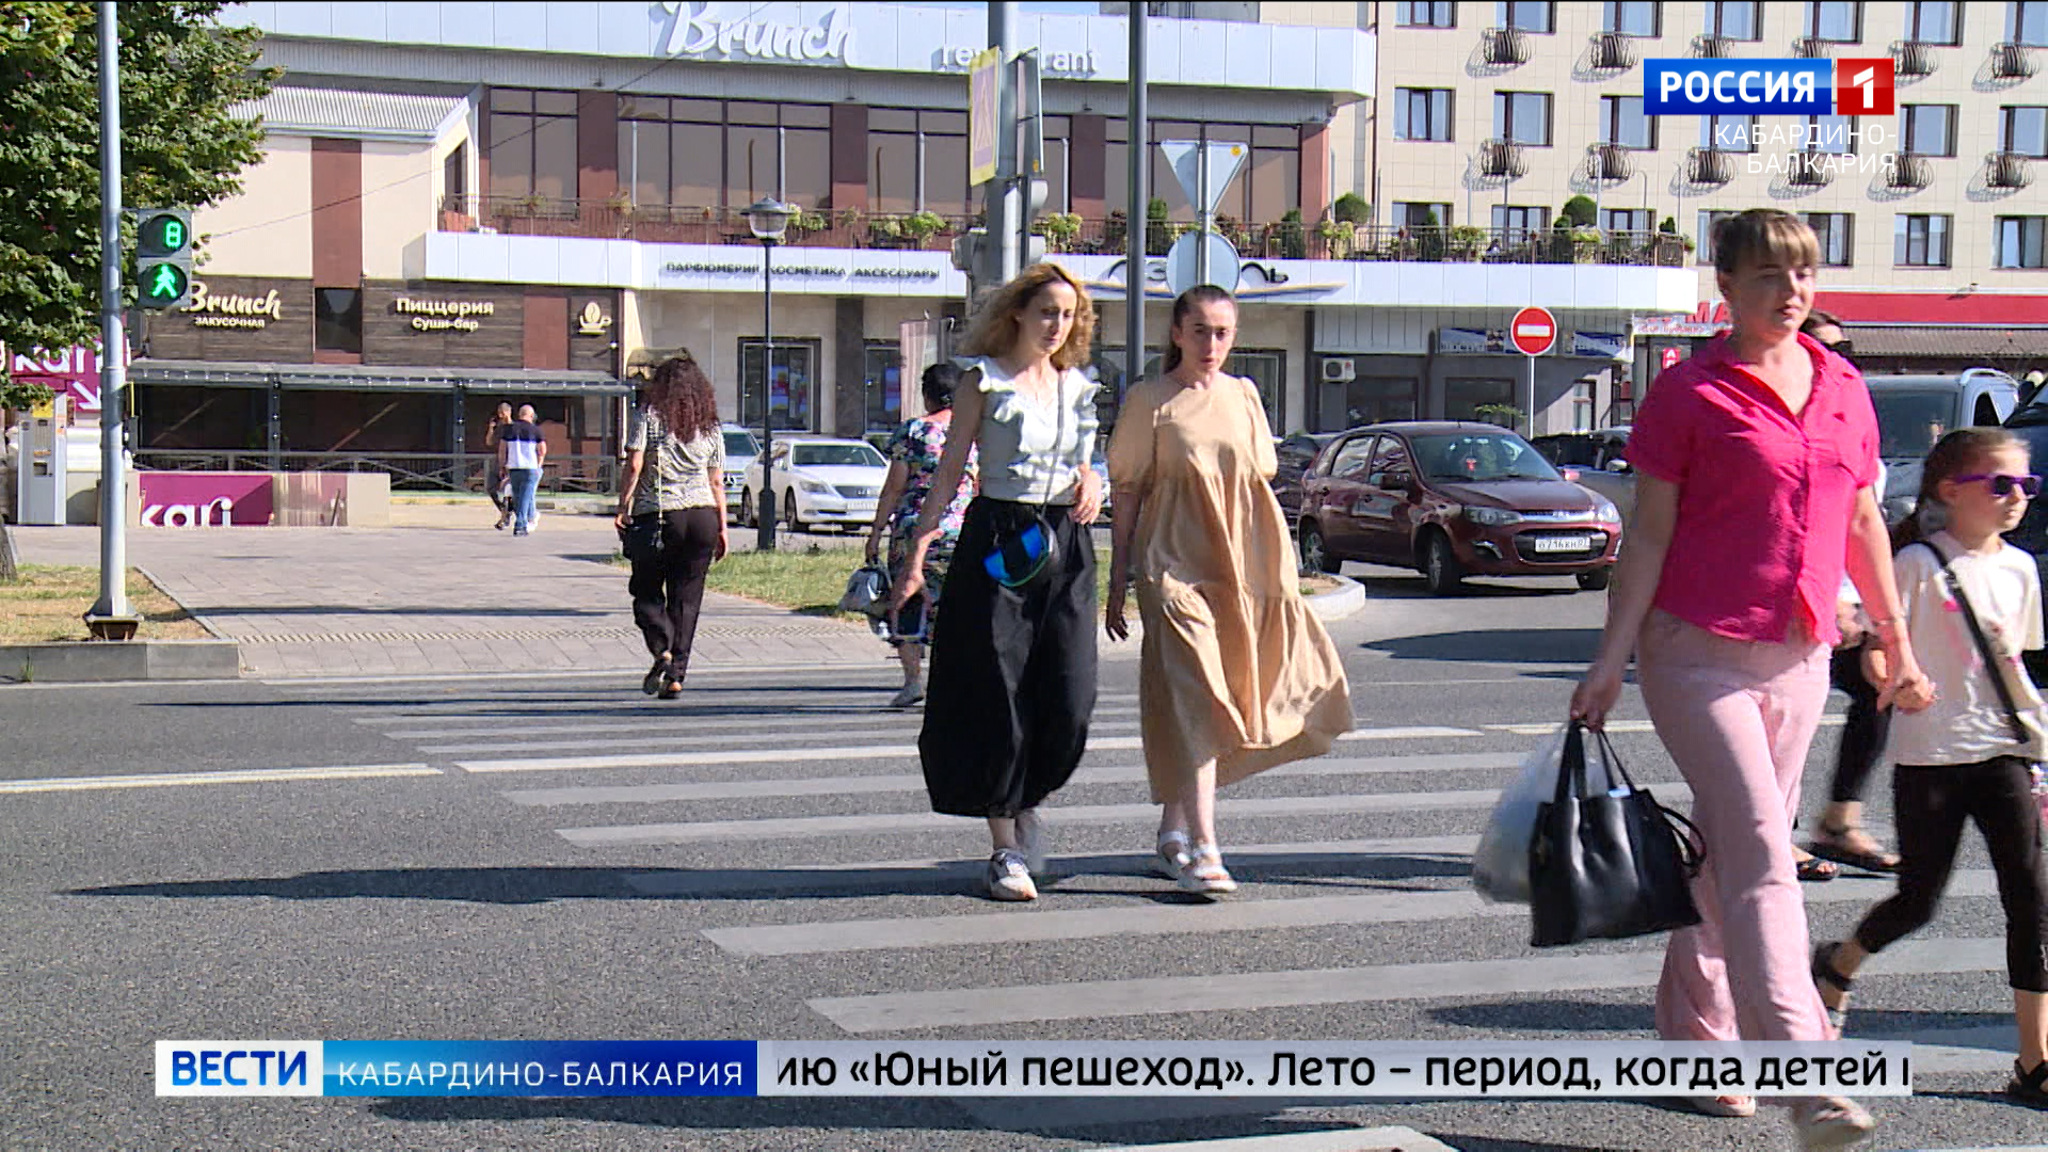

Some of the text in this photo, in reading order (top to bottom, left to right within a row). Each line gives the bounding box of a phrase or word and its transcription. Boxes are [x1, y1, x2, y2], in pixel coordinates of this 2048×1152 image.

[653, 2, 858, 68] Brunch
[181, 280, 282, 320] Brunch
[396, 297, 495, 317] Пиццерия
[195, 316, 266, 329] ЗАКУСОЧНАЯ
[412, 316, 479, 332] Суши-бар
